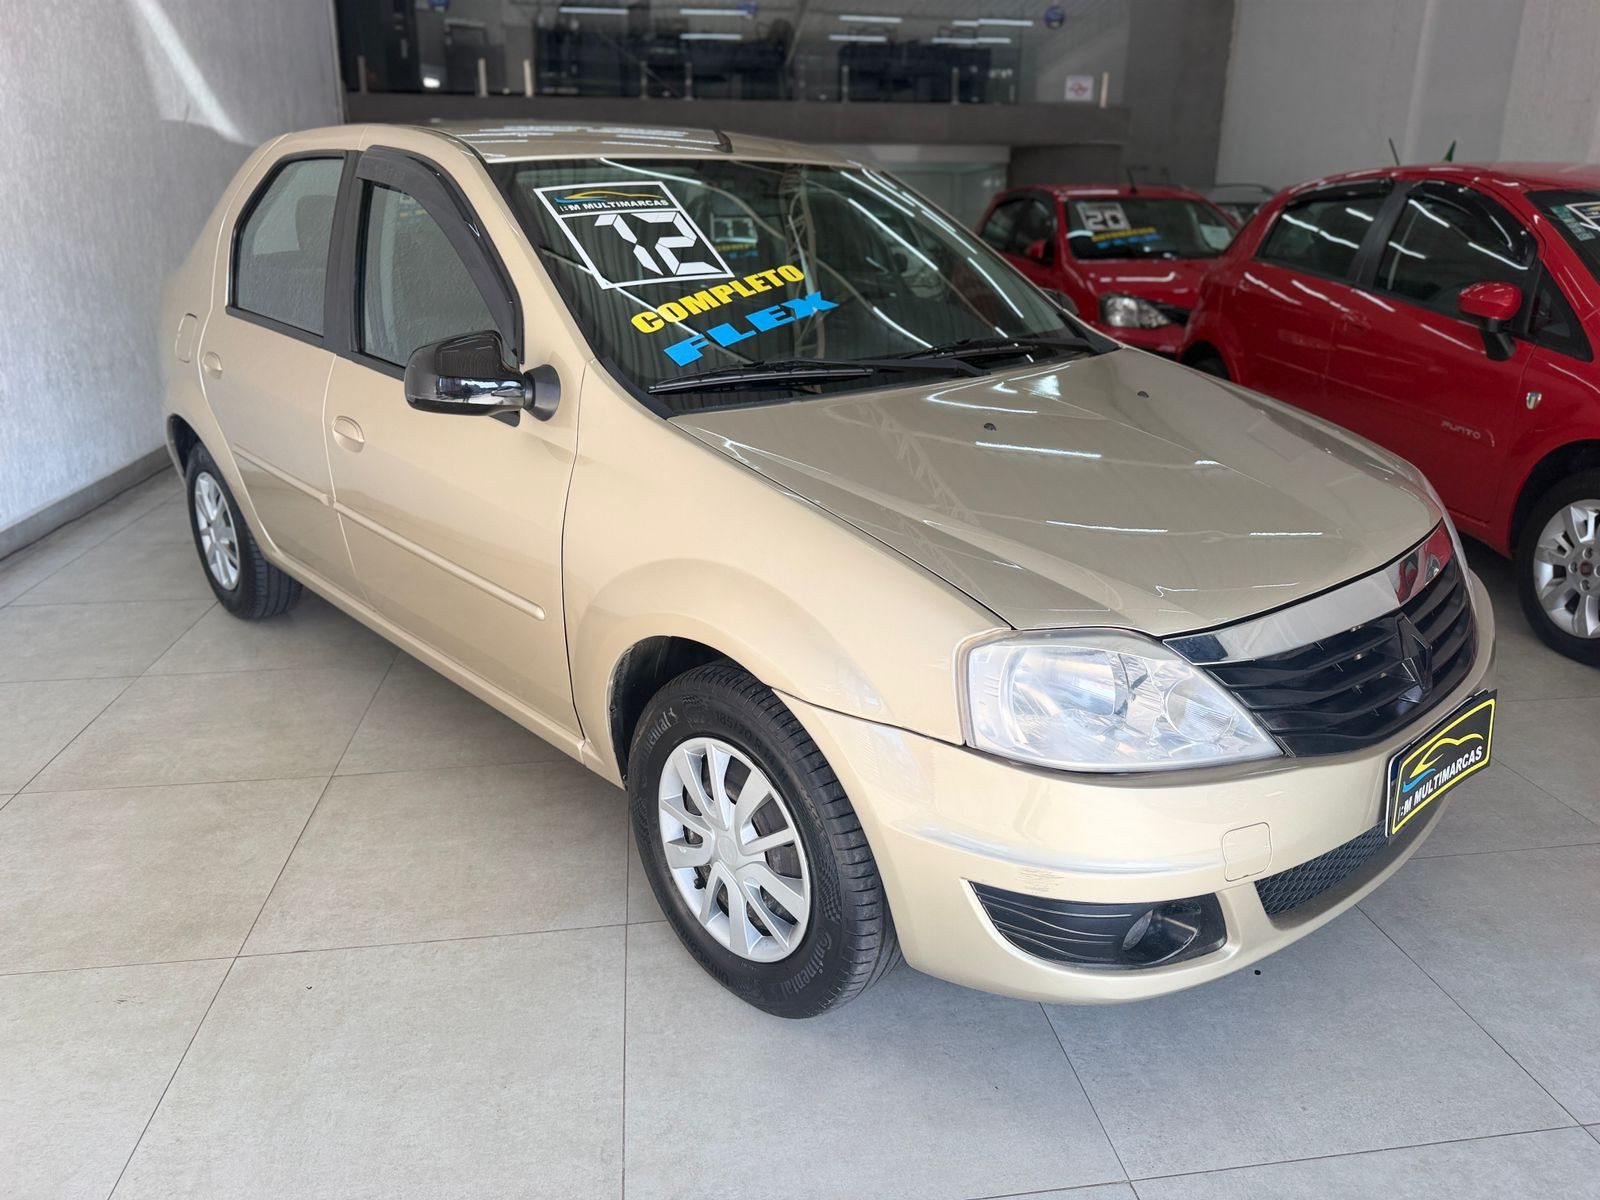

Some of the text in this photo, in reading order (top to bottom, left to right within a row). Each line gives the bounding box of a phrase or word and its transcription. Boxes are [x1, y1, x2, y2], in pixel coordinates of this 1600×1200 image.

[583, 199, 669, 210] MULTIMARCAS
[1085, 211, 1124, 229] 20
[594, 212, 724, 276] 12
[631, 264, 805, 334] COMPLETO
[664, 291, 839, 367] FLEX
[1413, 745, 1483, 806] MULTIMARCAS
